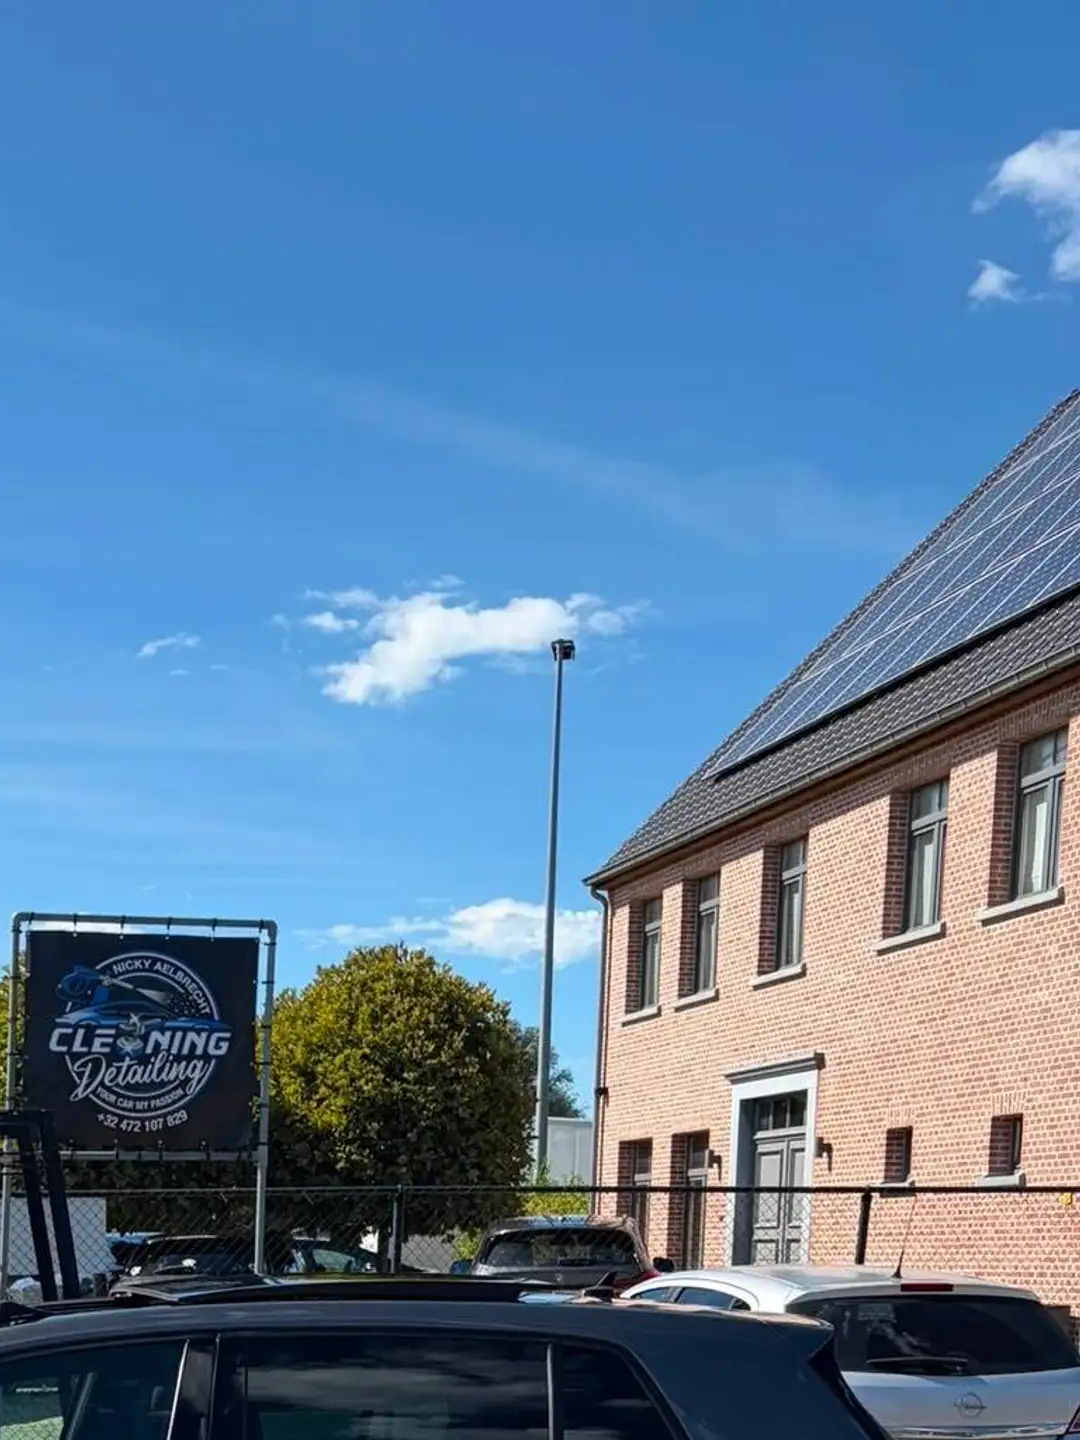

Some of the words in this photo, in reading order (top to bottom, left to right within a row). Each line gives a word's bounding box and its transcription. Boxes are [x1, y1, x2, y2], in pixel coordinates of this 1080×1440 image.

[112, 959, 152, 975] NICKY
[153, 960, 211, 1015] AELBRECHT
[48, 1027, 232, 1056] CLENING
[70, 1051, 209, 1102] Detailing
[117, 1098, 134, 1110] CAR
[135, 1100, 149, 1110] MY
[150, 1087, 185, 1109] PASSION
[97, 1113, 119, 1129] +32
[119, 1119, 141, 1132] 472
[144, 1118, 165, 1132] 107
